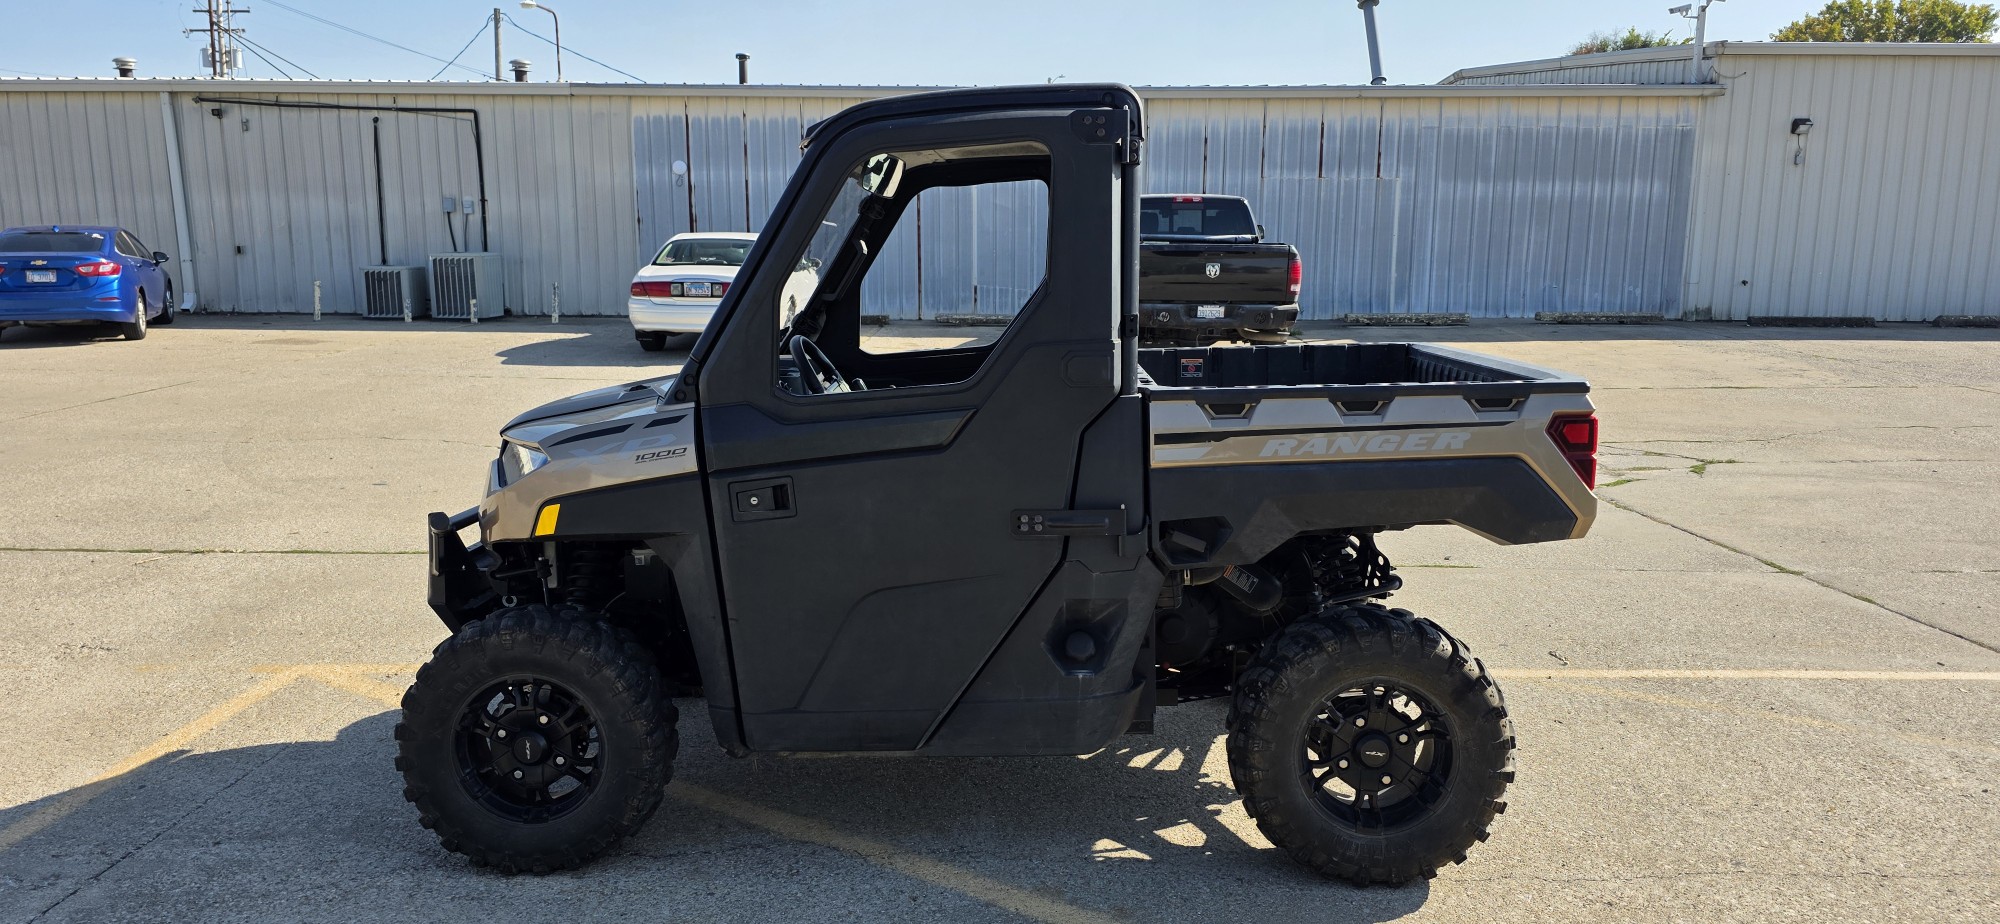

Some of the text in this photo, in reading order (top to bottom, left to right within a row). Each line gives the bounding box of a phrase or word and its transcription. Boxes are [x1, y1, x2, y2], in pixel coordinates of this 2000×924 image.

[554, 433, 678, 471] XP
[635, 447, 688, 461] 1000
[1259, 432, 1470, 457] RANGER
